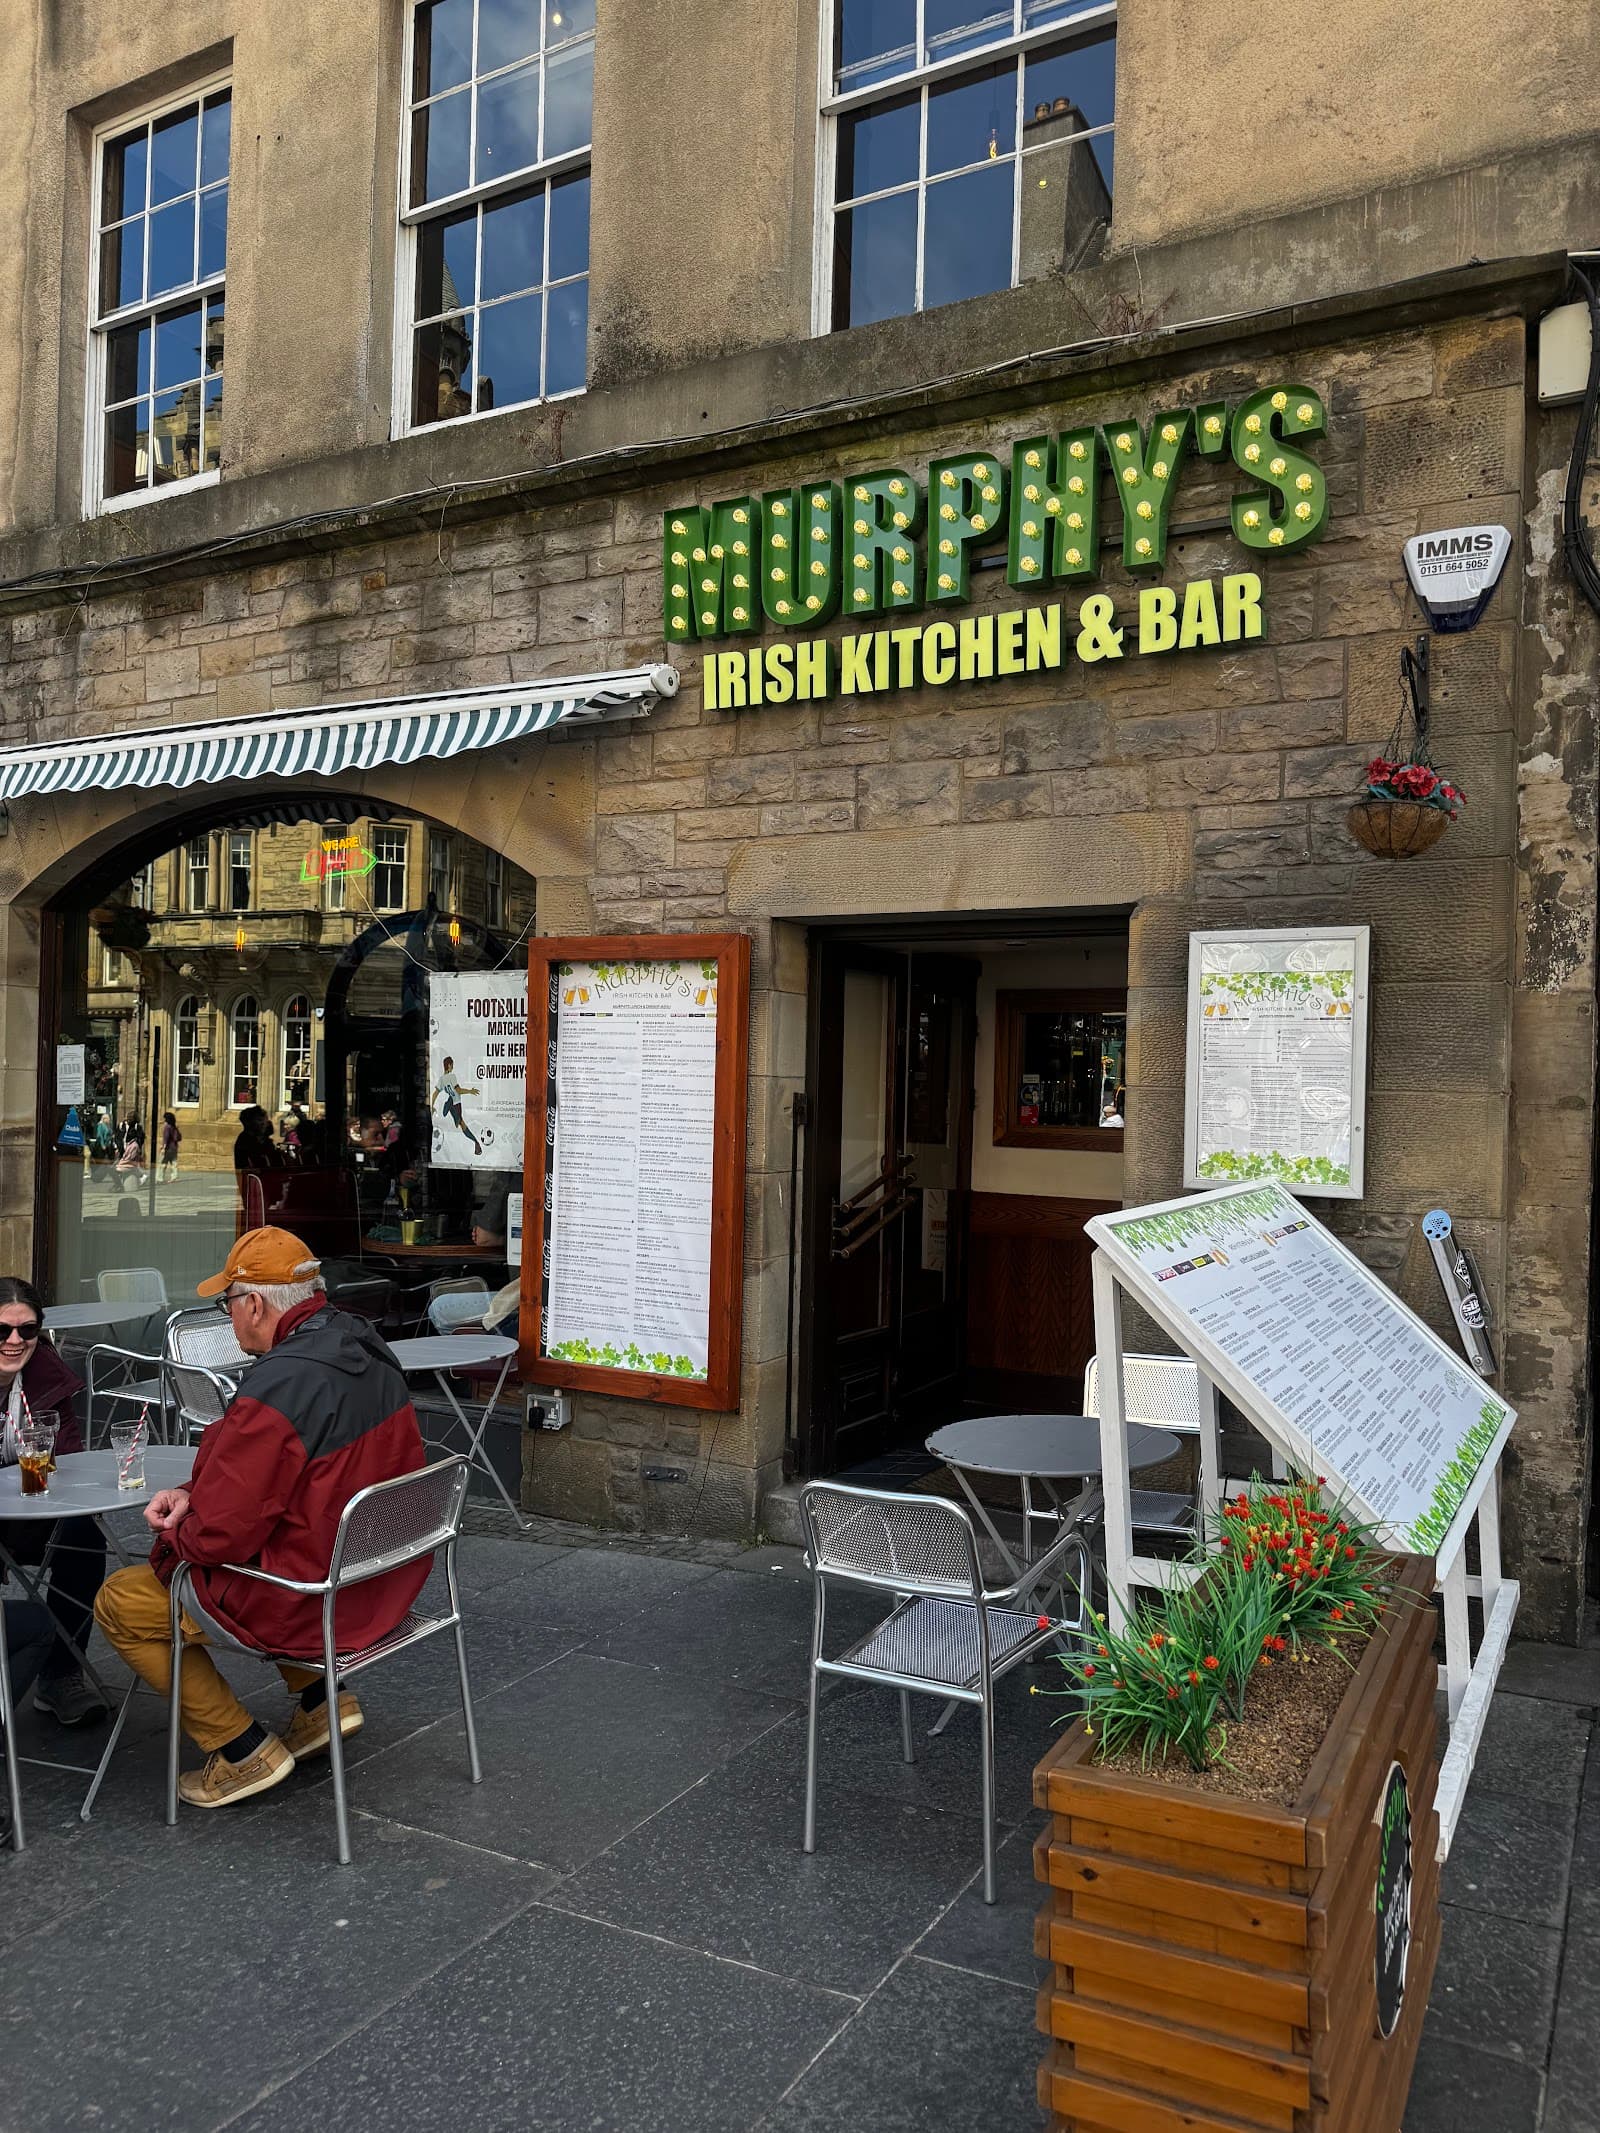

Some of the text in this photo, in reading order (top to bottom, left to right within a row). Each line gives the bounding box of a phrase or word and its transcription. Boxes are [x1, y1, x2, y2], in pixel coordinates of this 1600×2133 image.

[664, 384, 1328, 643] MURPHY'S
[1417, 533, 1493, 560] IMMS
[1420, 558, 1489, 575] 0131 664 5052
[703, 572, 1263, 711] IRISH KITCHEN & BAR
[321, 836, 359, 852] WE ARE
[467, 998, 528, 1018] FOOTBALL
[486, 1043, 505, 1057] LIVE
